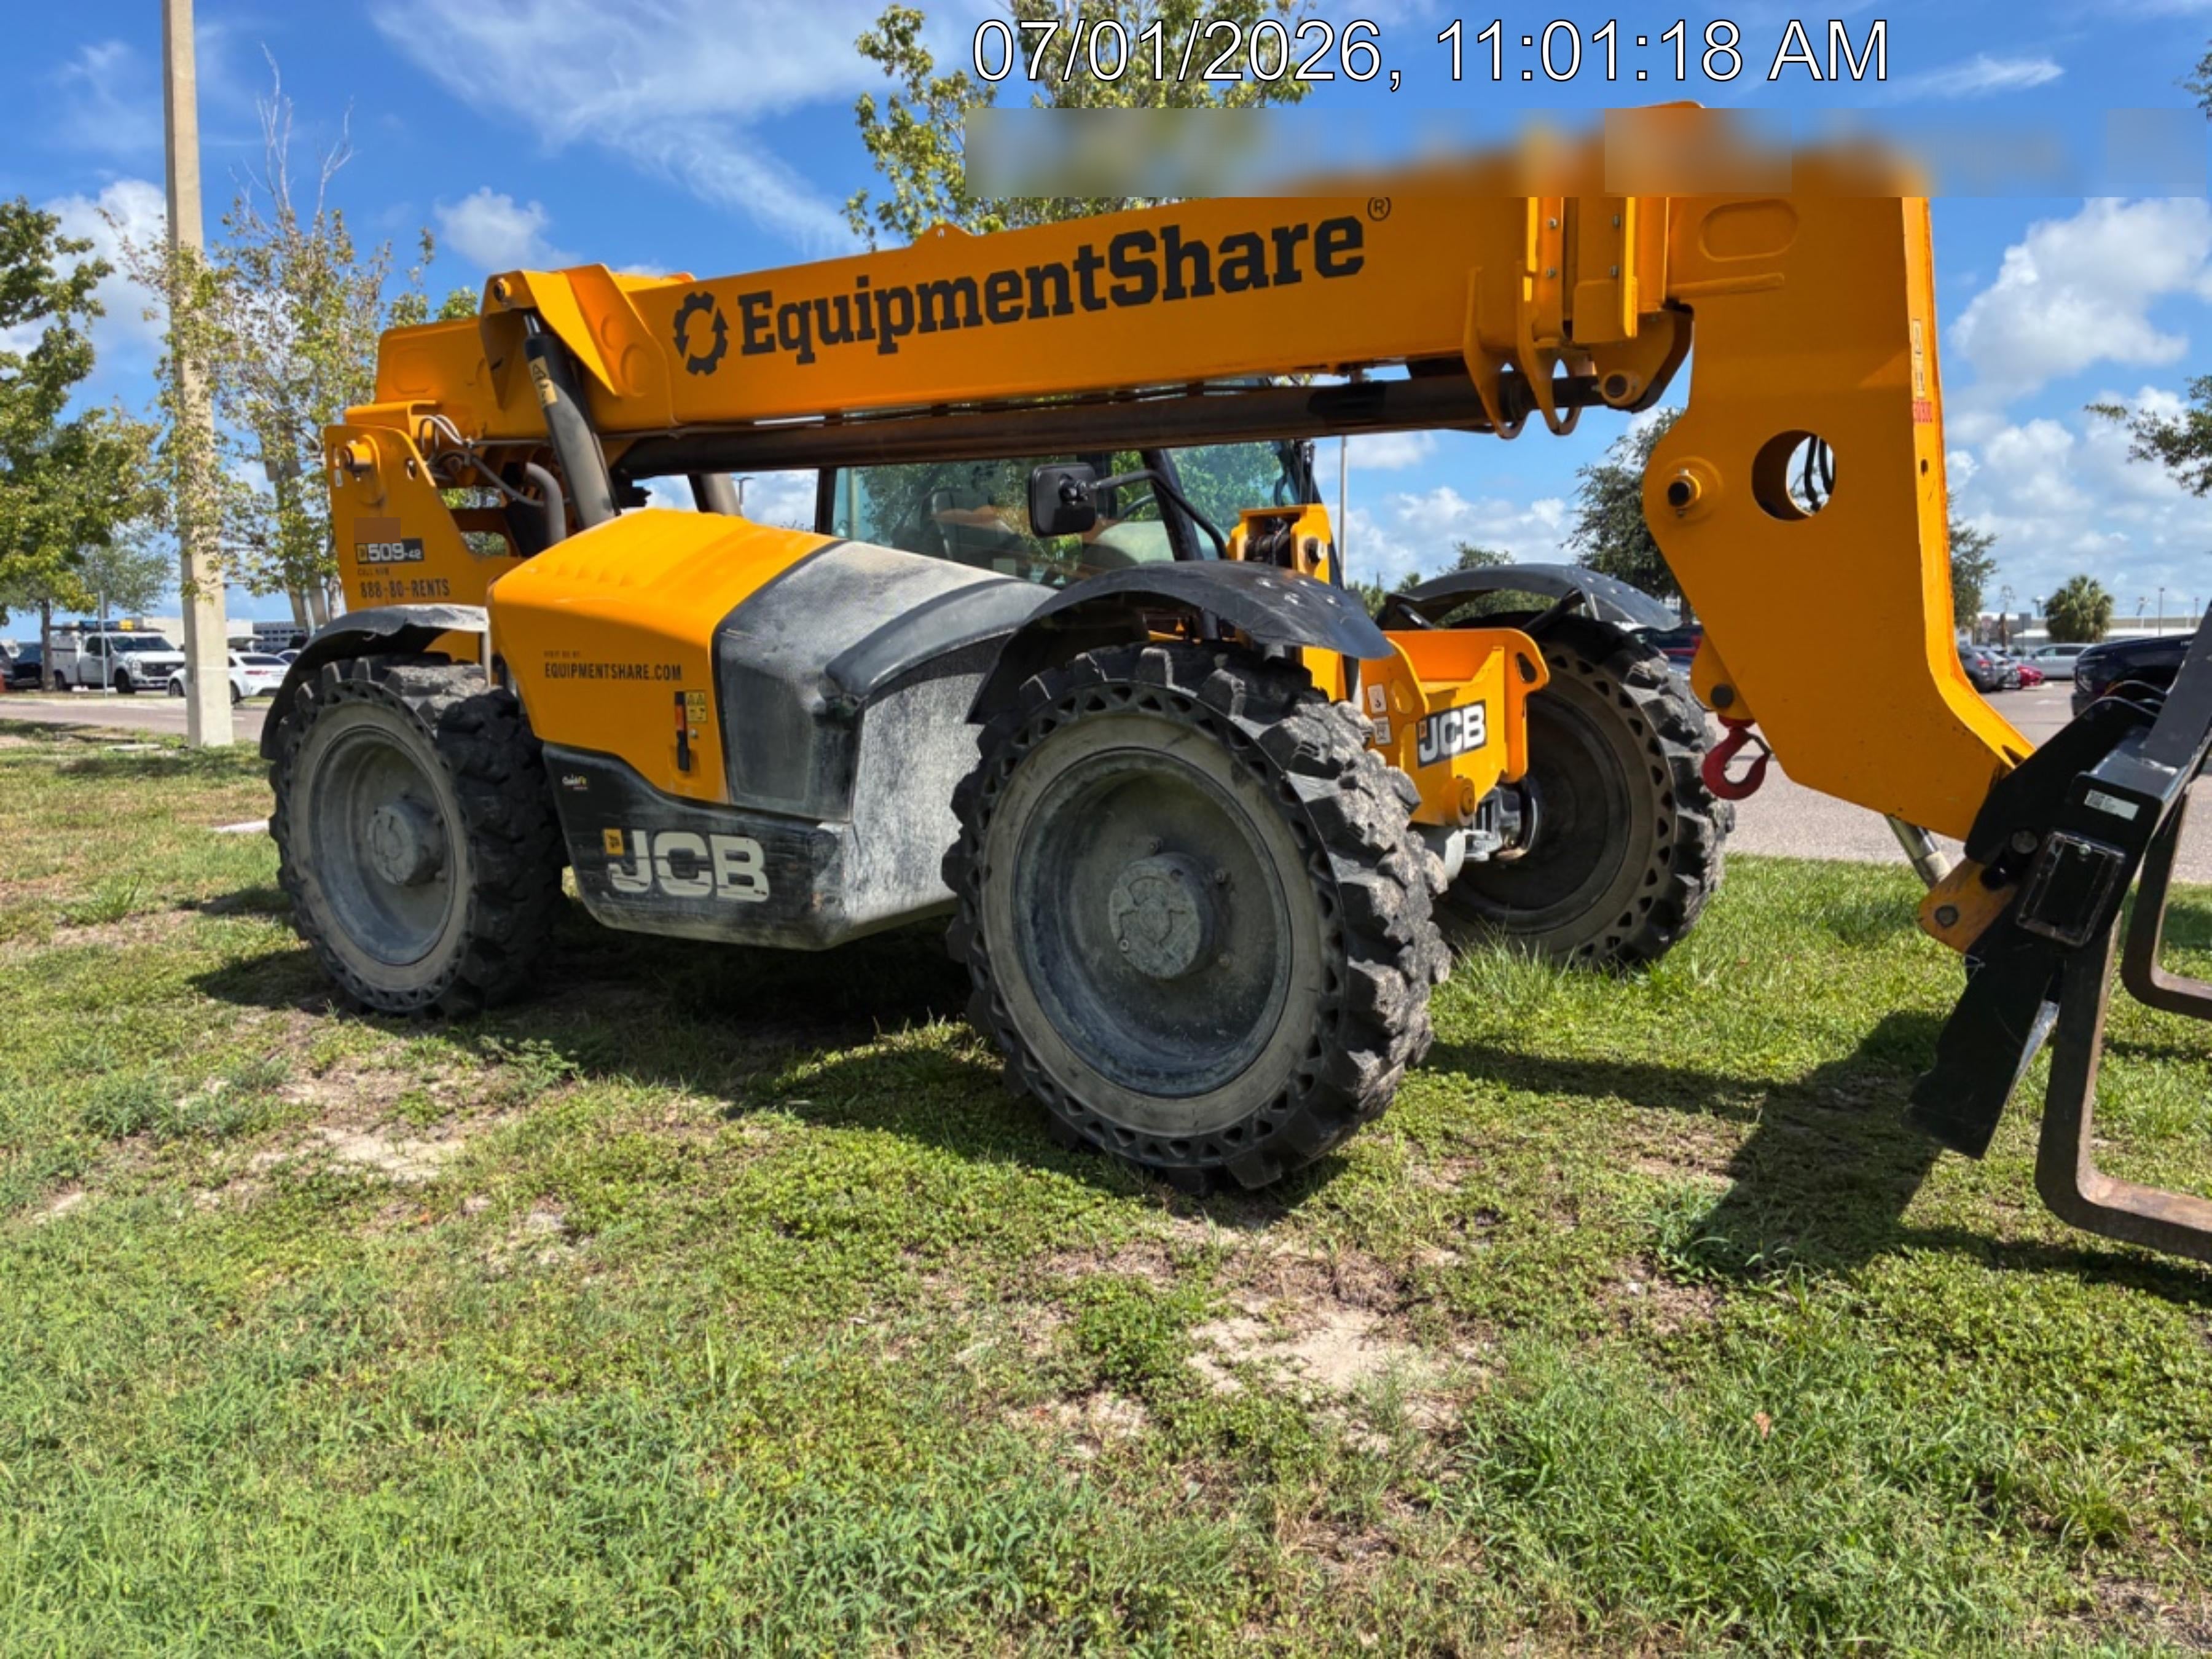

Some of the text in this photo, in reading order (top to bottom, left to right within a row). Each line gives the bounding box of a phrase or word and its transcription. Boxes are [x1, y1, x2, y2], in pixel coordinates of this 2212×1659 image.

[544, 662, 683, 681] EQUIPMENTSHARE.COM
[1419, 704, 1486, 763] JCB
[605, 830, 770, 903] JCB
